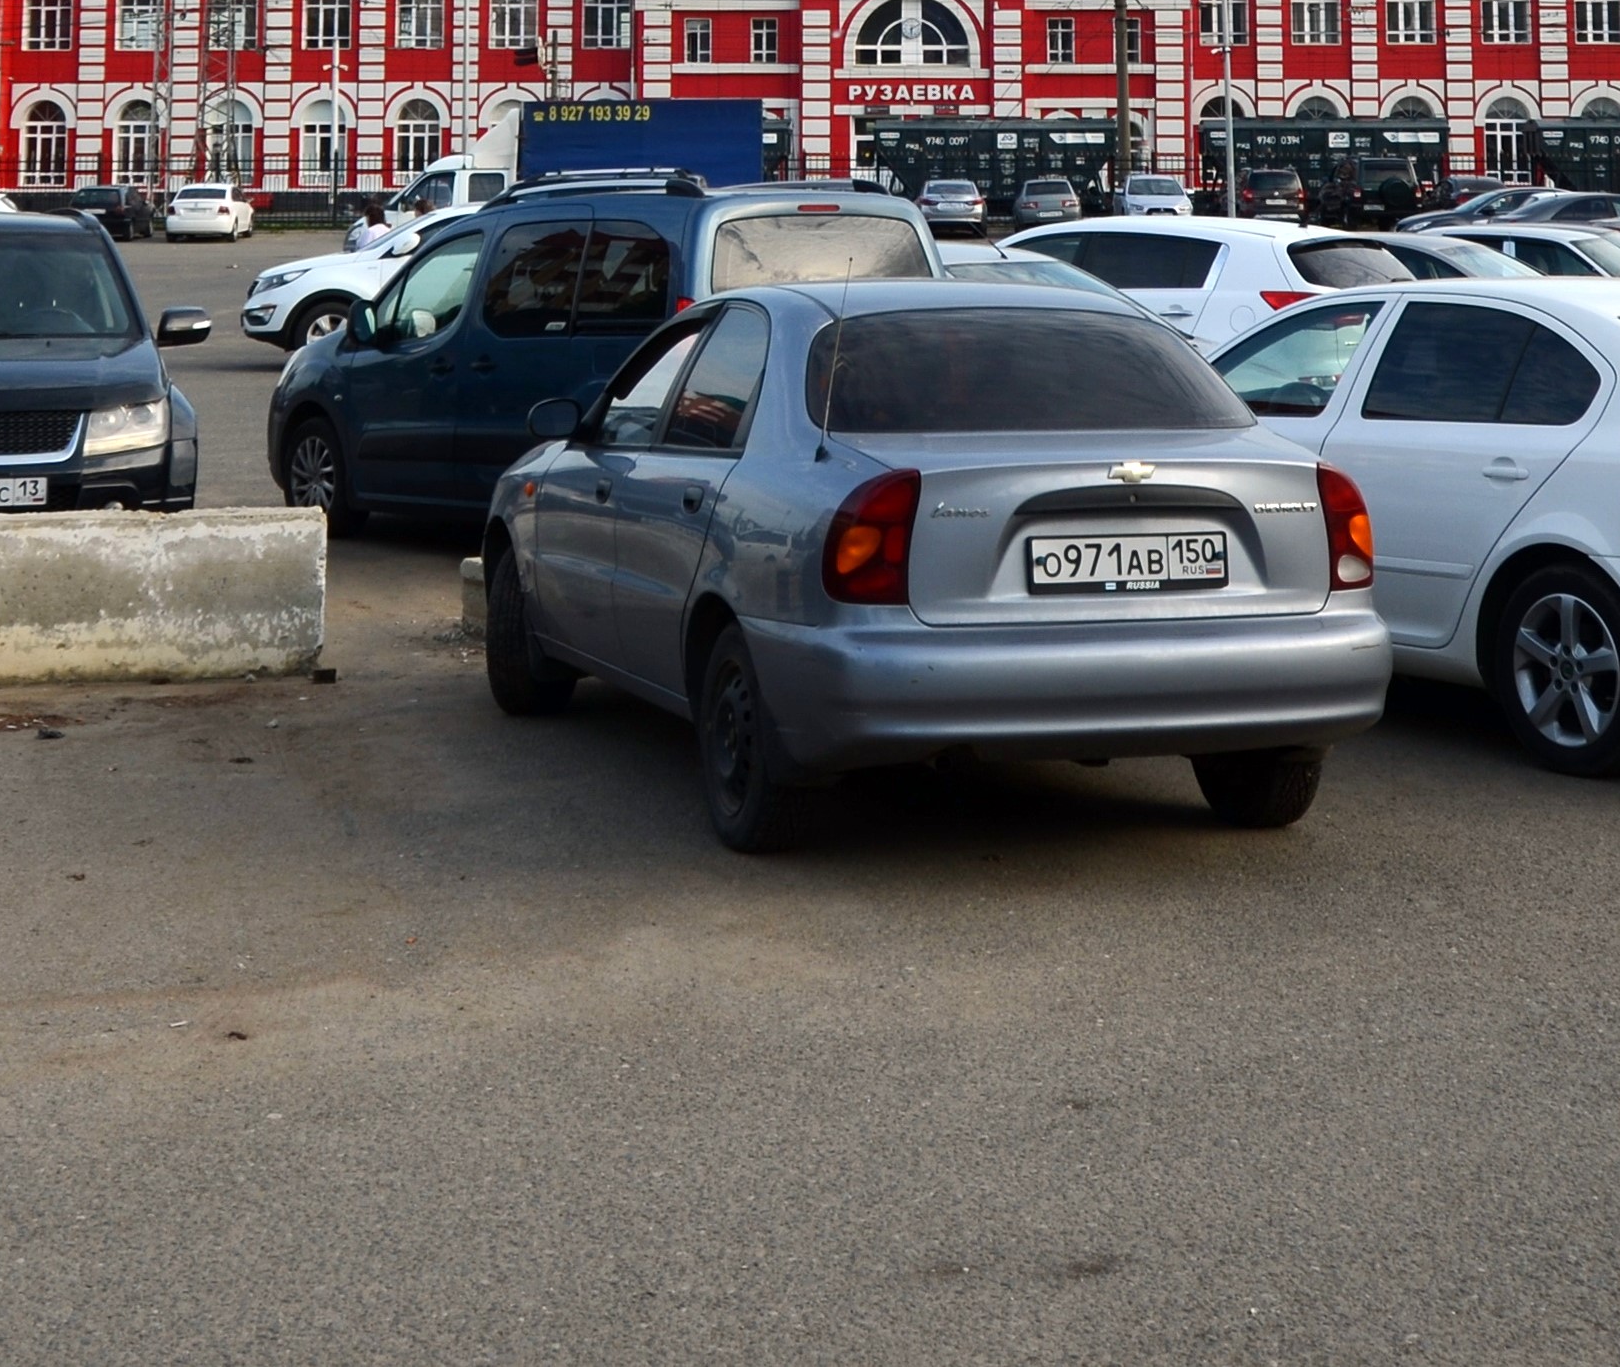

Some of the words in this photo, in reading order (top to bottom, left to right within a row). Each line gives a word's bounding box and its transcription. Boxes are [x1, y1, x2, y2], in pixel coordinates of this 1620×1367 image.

[848, 84, 976, 101] РУЗАЕВКА
[548, 105, 557, 121] 8
[561, 105, 585, 121] 927
[588, 105, 612, 121] 193
[615, 105, 631, 121] 39
[634, 104, 651, 121] 29
[925, 136, 945, 146] 9740
[949, 136, 969, 146] 0097
[1256, 135, 1277, 145] 9740
[1589, 135, 1610, 145] 9740
[18, 479, 40, 497] 13
[1253, 502, 1318, 514] CHEVROLET
[1042, 541, 1165, 578] О971АВ
[1170, 538, 1216, 565] 150
[1181, 564, 1206, 575] RUS
[1125, 580, 1161, 590] RUSSIA
